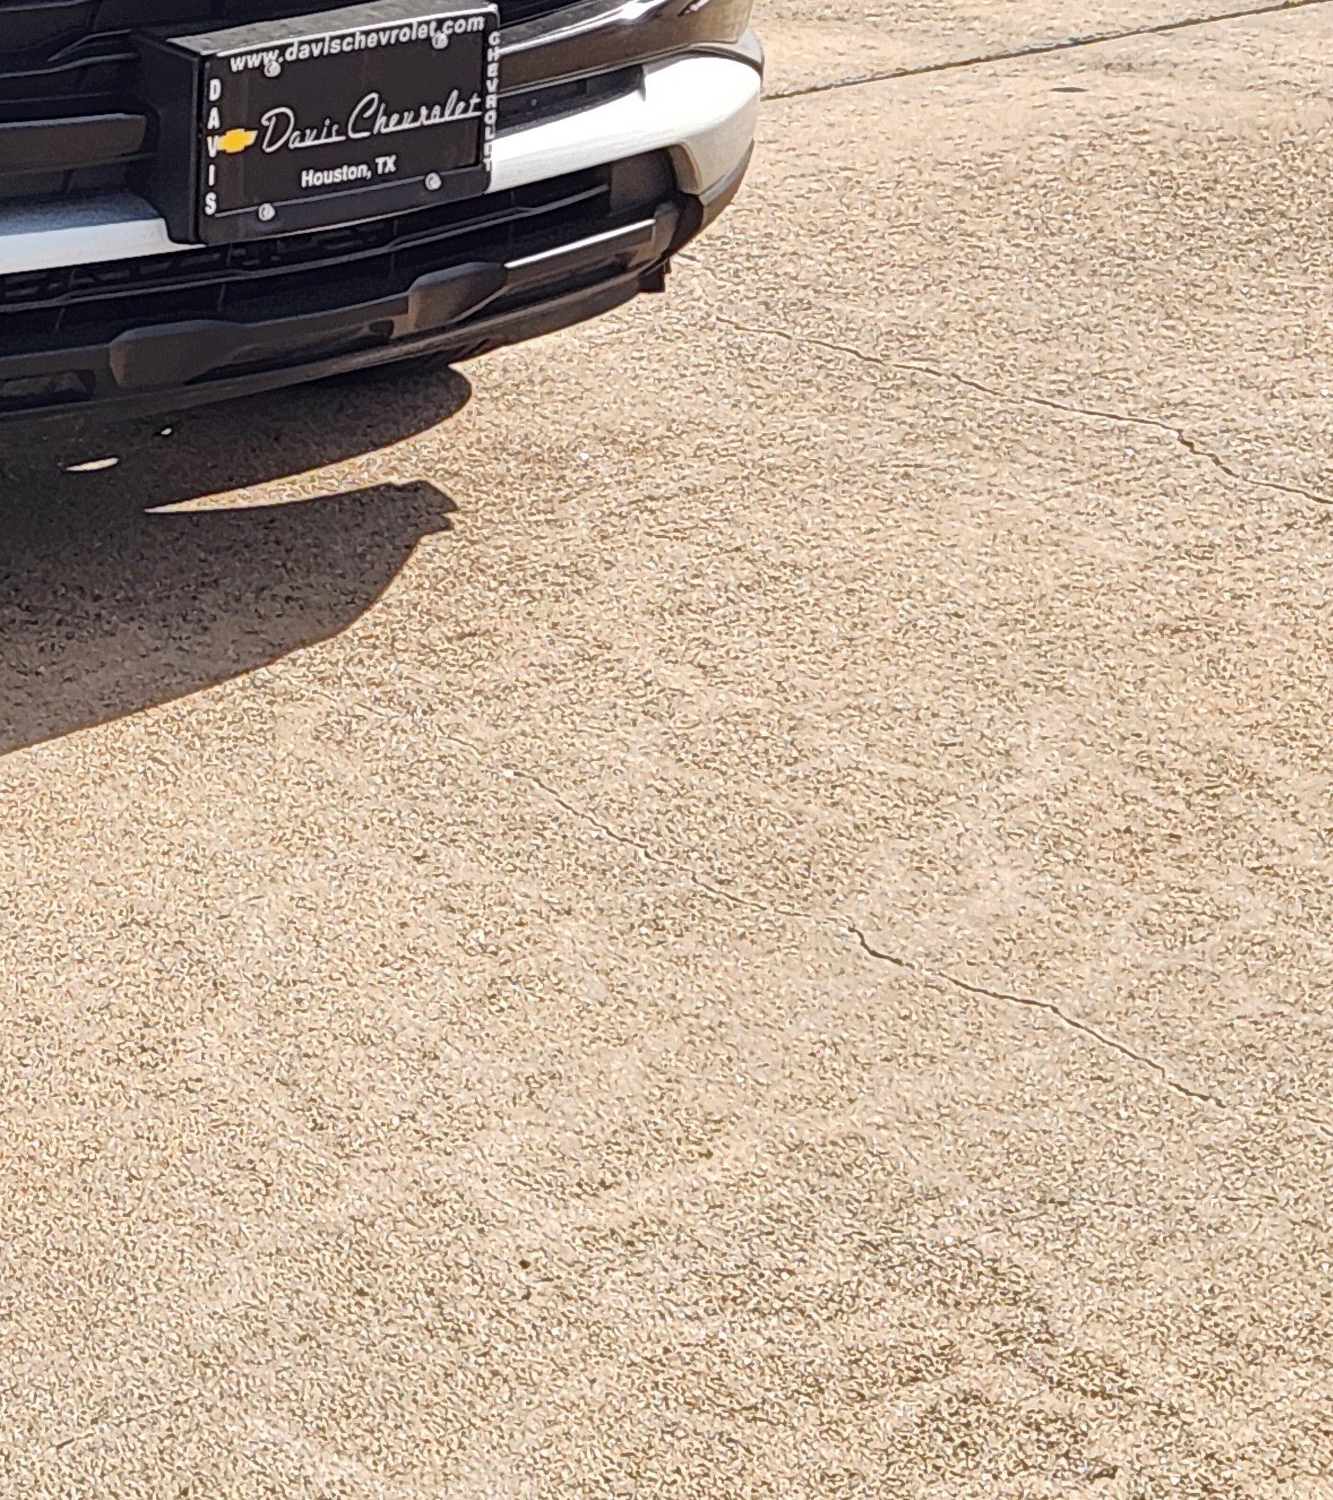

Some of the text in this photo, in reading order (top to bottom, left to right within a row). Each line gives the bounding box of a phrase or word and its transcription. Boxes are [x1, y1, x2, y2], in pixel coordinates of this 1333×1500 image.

[230, 16, 486, 73] www.davischevrolet.com
[204, 78, 222, 217] DAVIS
[260, 89, 484, 154] Davis Chevrolet
[300, 154, 398, 189] Houston, TX
